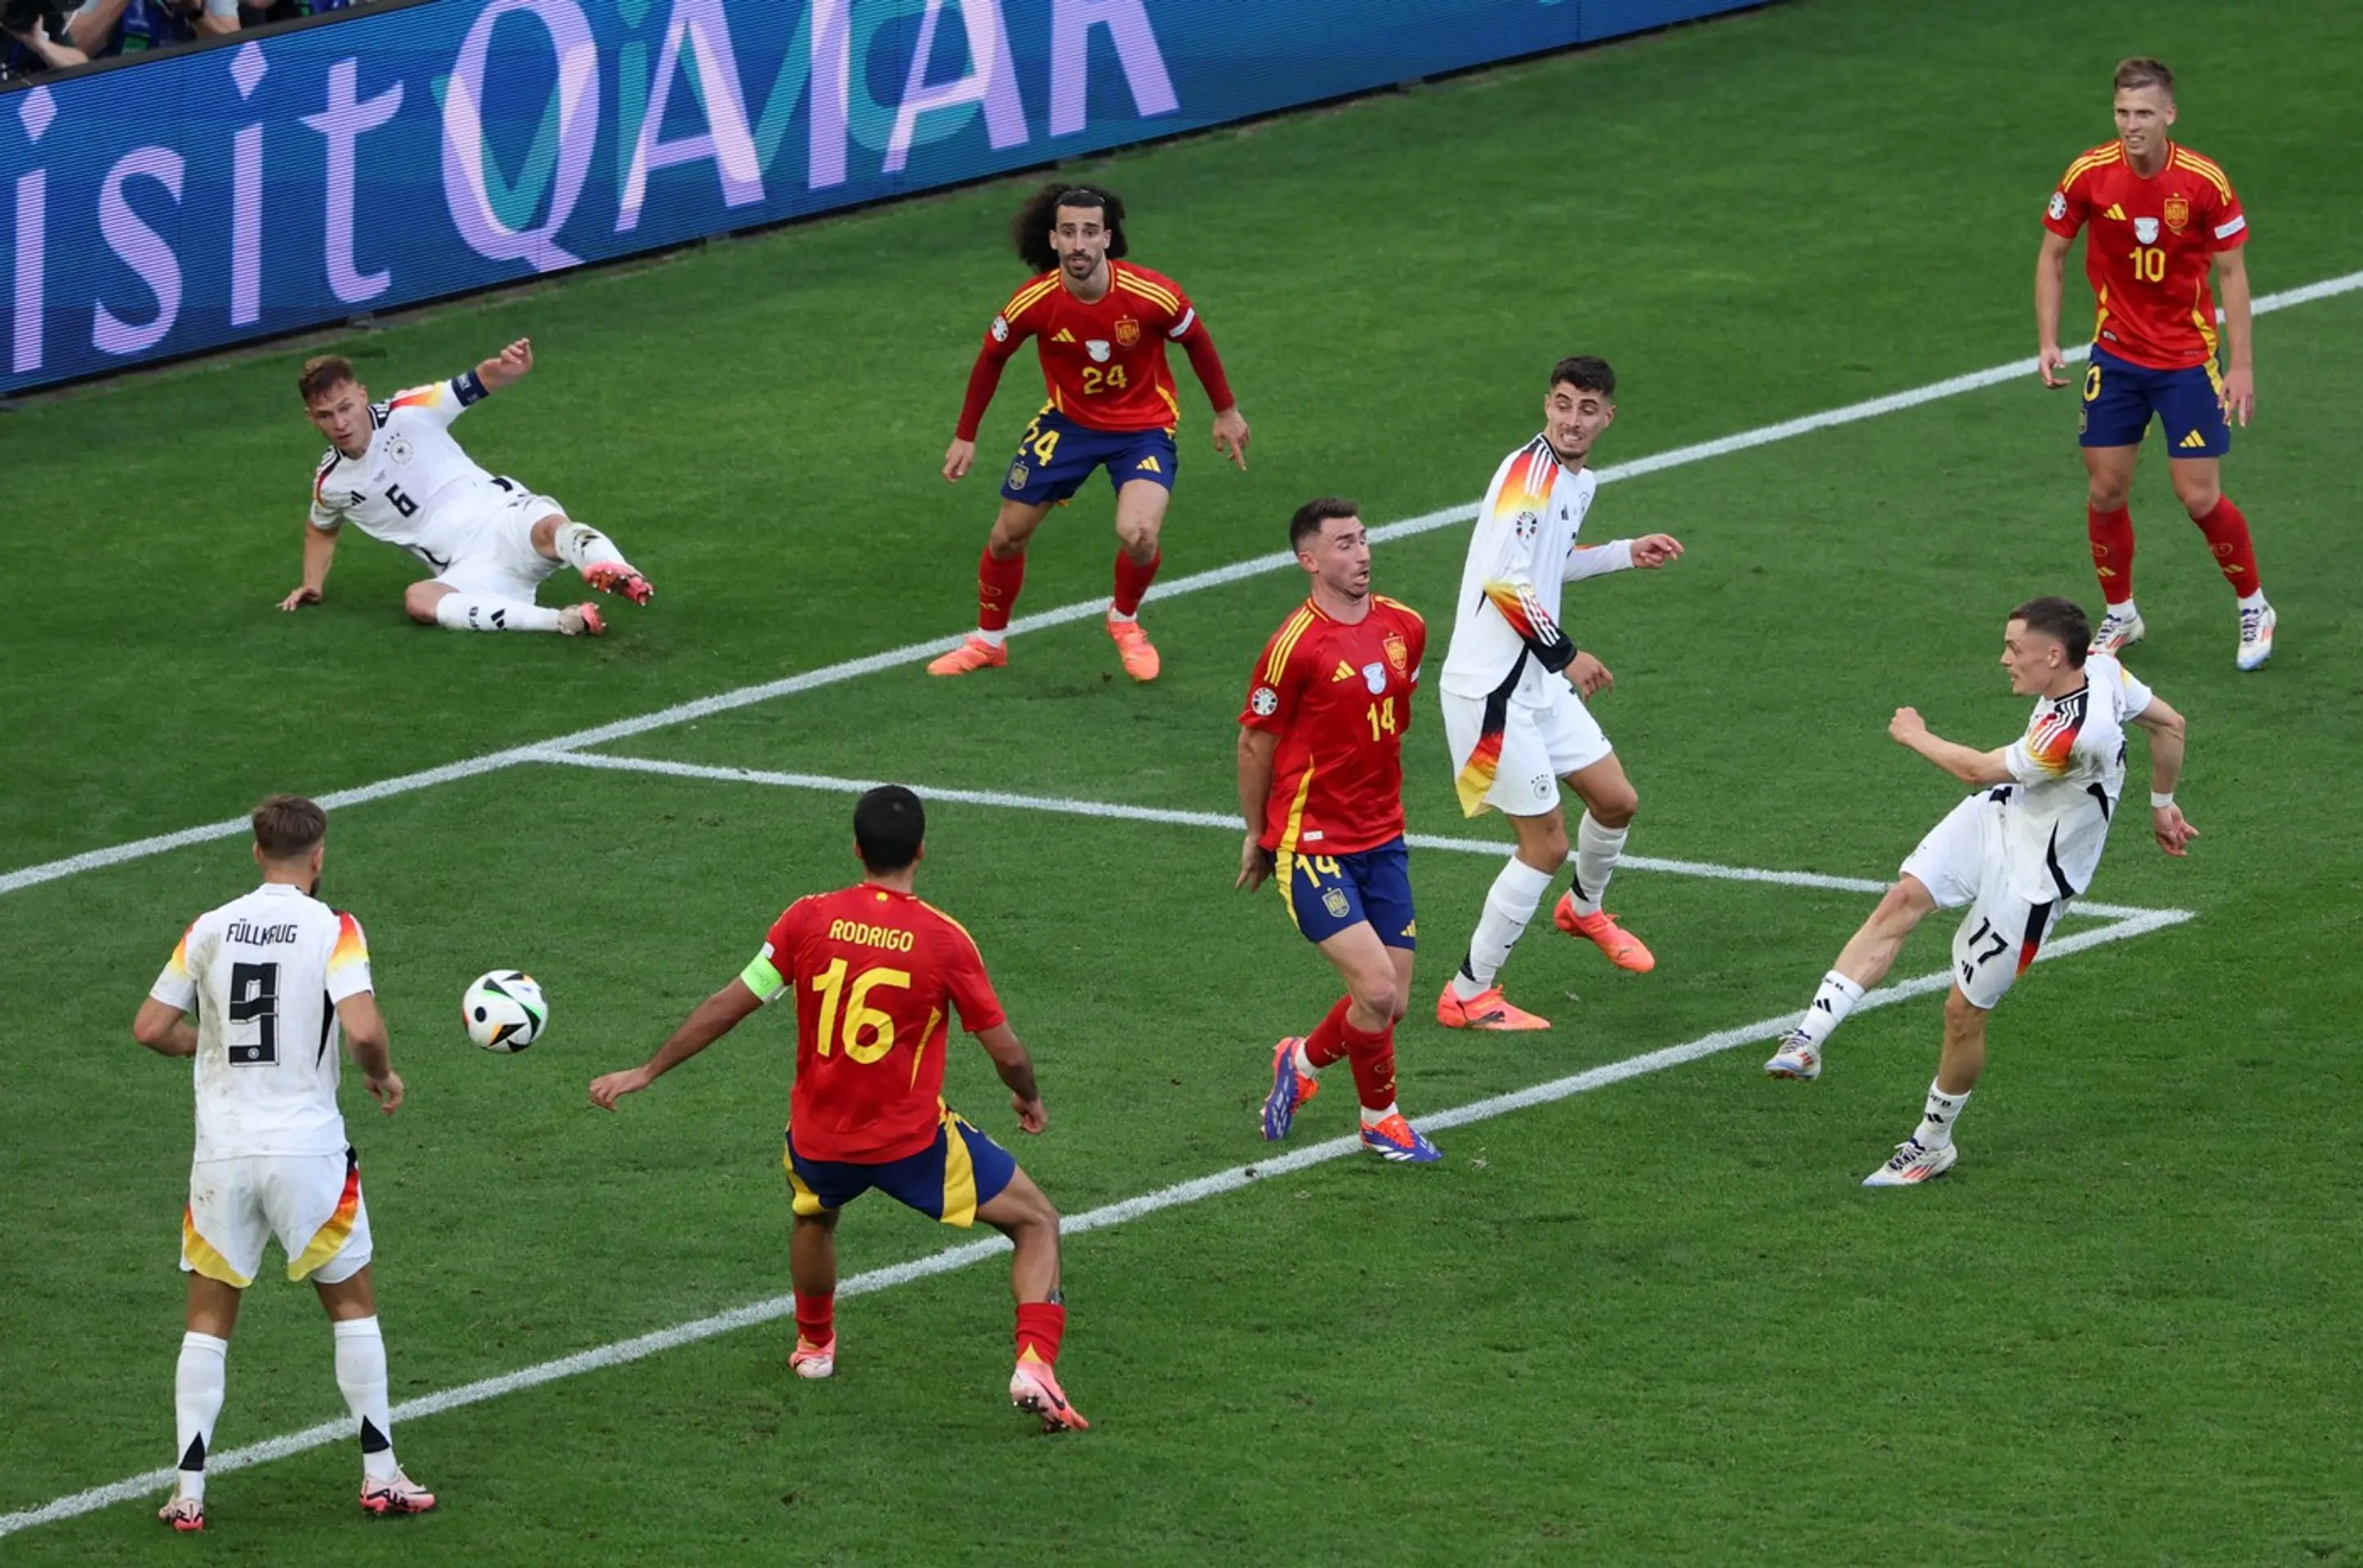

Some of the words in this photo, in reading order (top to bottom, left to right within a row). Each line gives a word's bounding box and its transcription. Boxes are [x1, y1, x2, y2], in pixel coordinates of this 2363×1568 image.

[2129, 246, 2165, 283] 10
[1082, 364, 1127, 395] 24
[2083, 362, 2102, 402] 0
[1018, 423, 1061, 467] 24
[385, 483, 419, 519] 6
[1367, 696, 1395, 742] 14
[1295, 854, 1343, 889] 14
[226, 917, 298, 947] FÜLLKRUG
[829, 918, 915, 953] RODRIGO
[1968, 915, 2009, 965] 17
[229, 962, 280, 1067] 9
[812, 957, 911, 1065] 16
